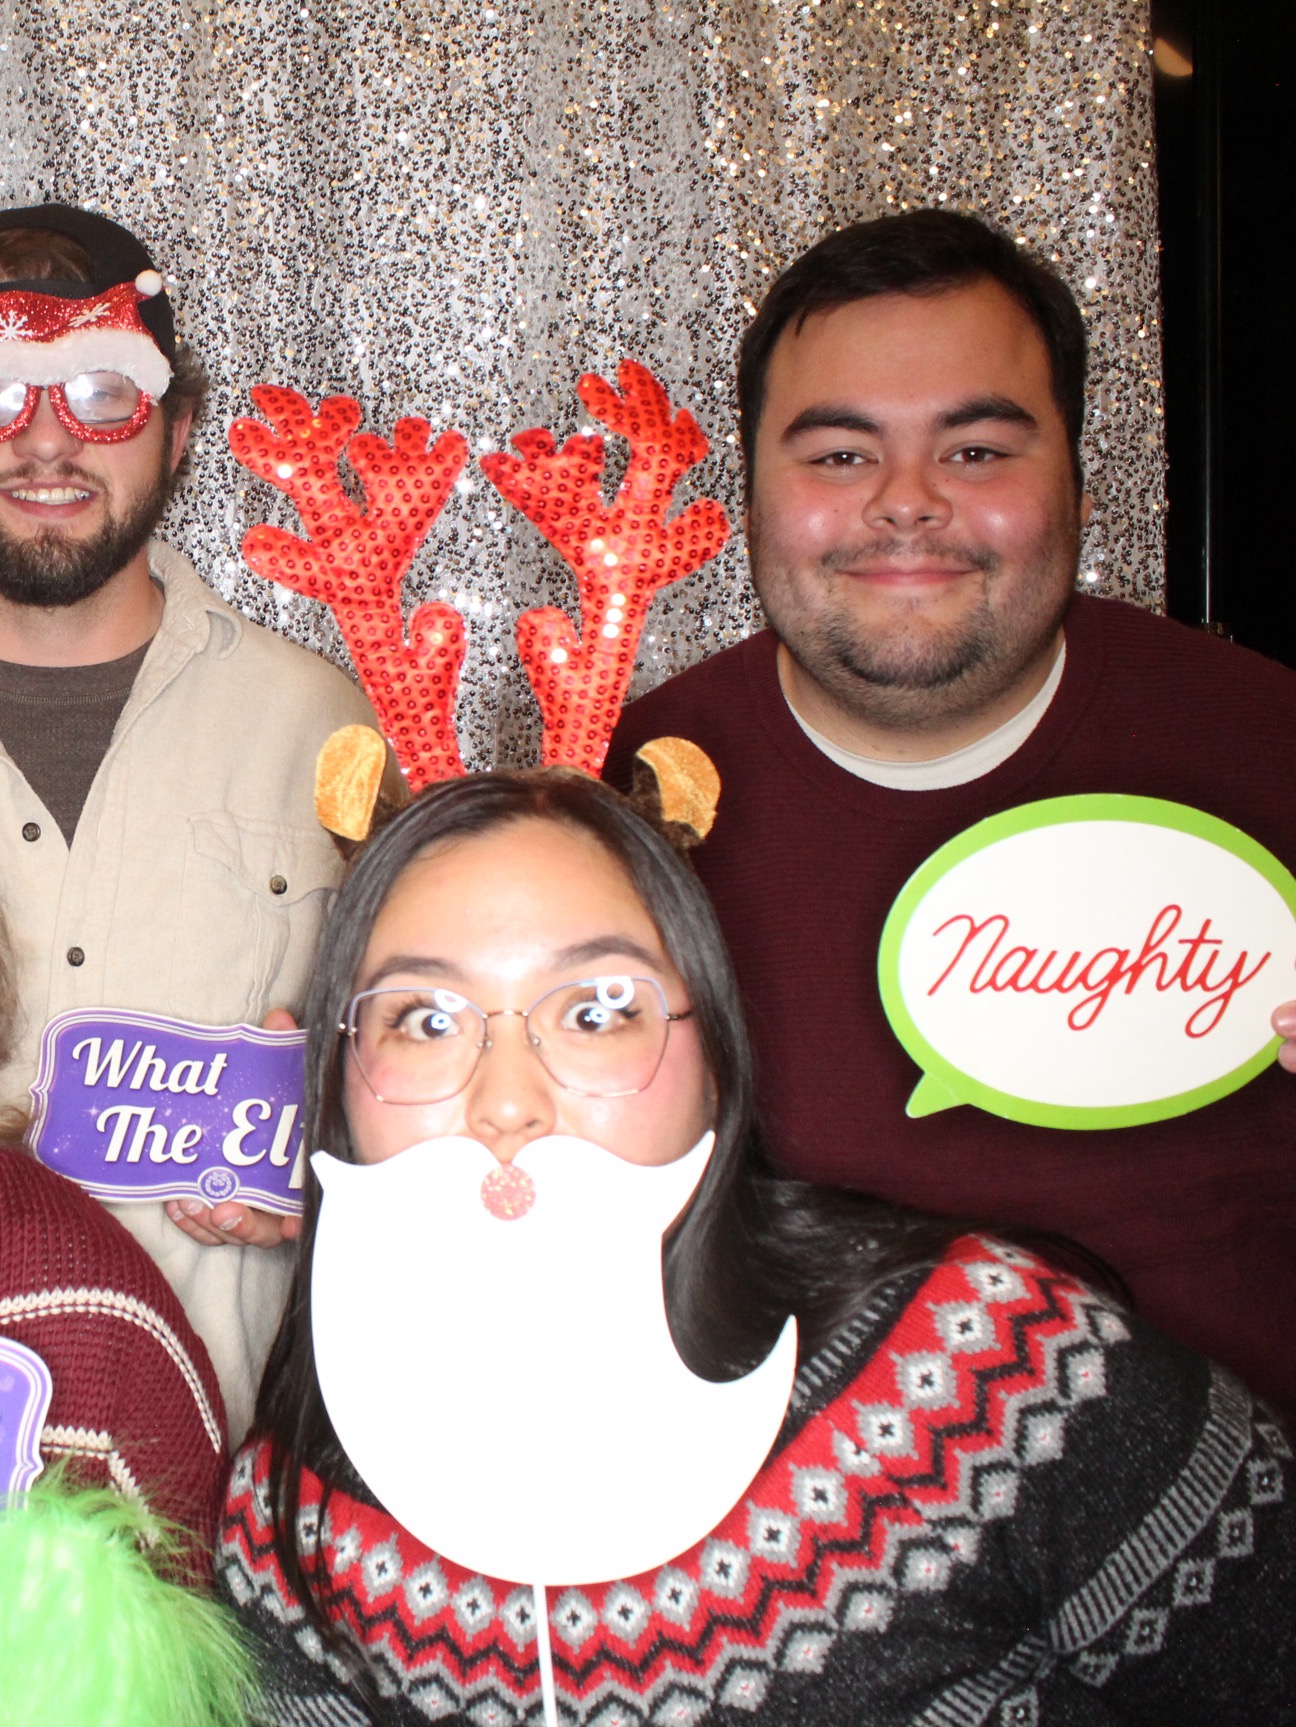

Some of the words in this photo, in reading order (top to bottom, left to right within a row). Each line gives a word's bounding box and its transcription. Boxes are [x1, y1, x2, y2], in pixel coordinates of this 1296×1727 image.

[927, 904, 1271, 1038] Naughty
[72, 1037, 227, 1095] What
[96, 1105, 202, 1164] The
